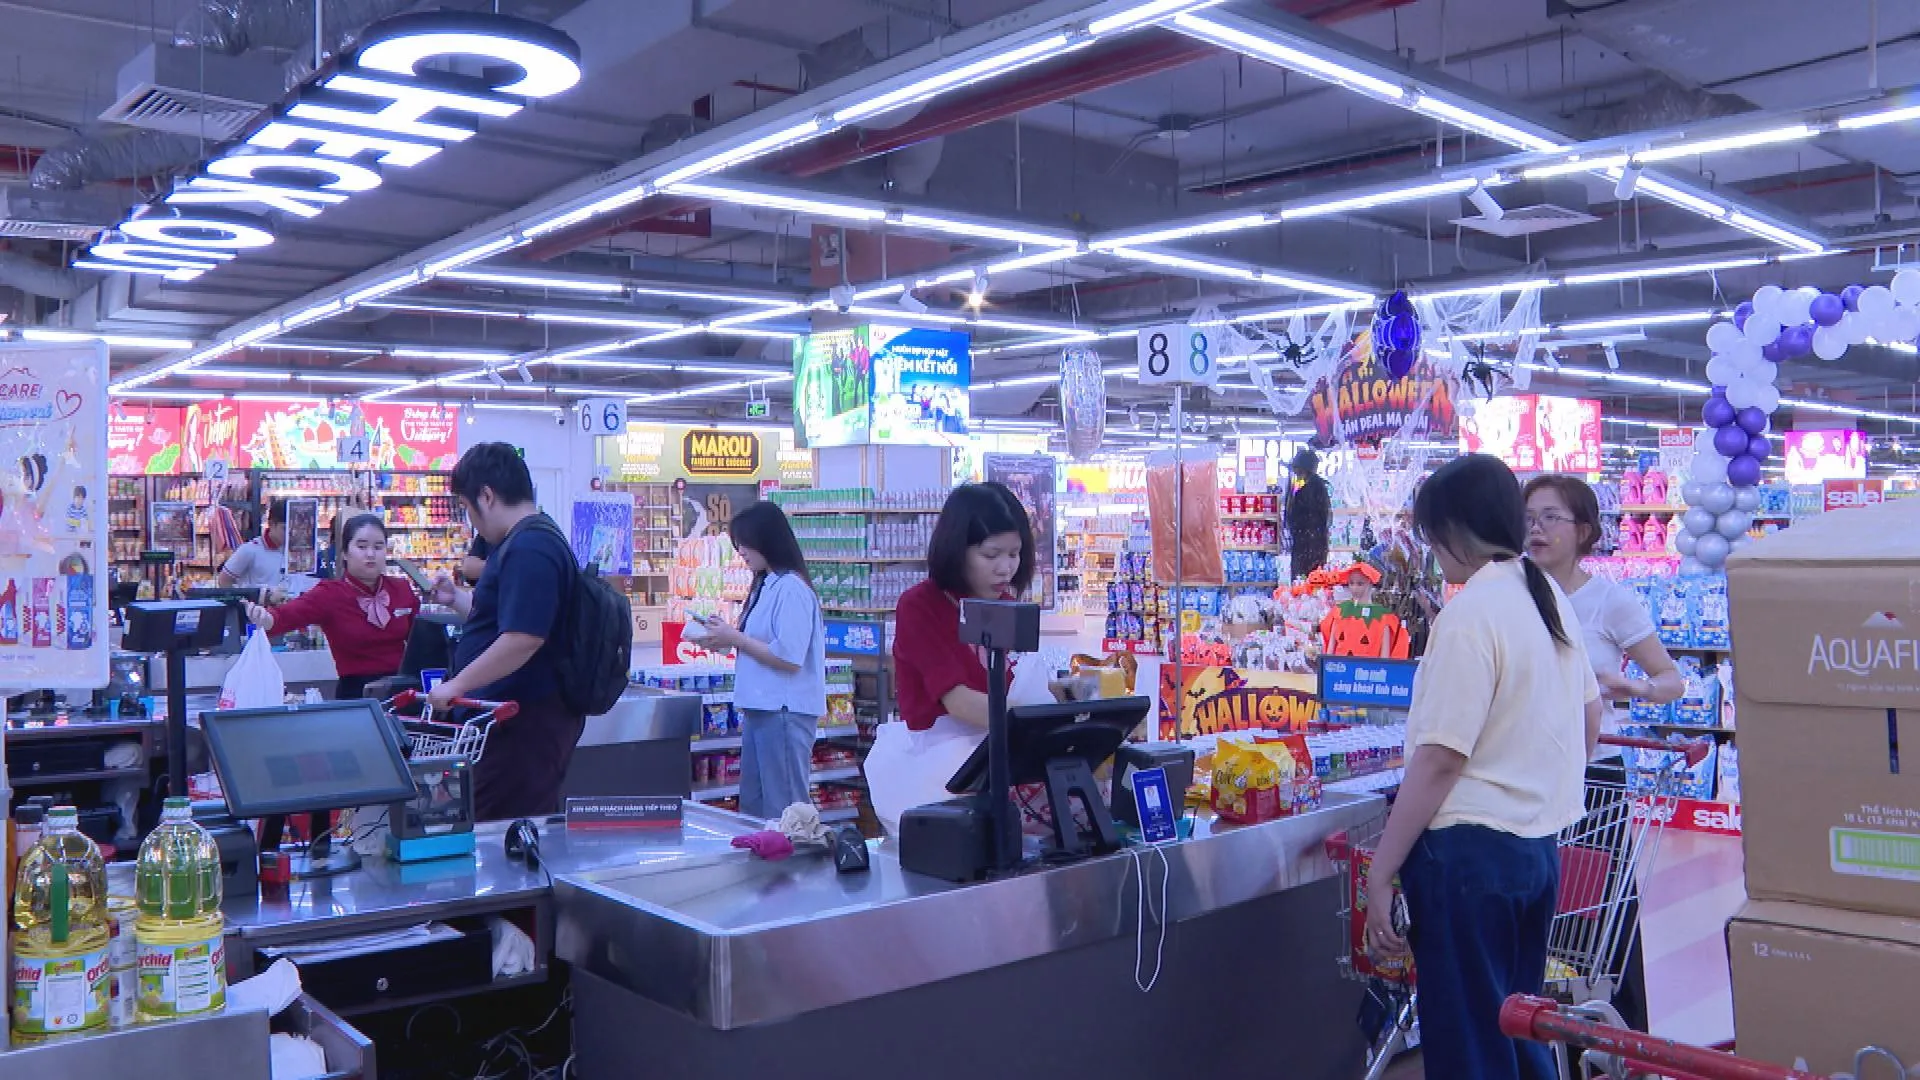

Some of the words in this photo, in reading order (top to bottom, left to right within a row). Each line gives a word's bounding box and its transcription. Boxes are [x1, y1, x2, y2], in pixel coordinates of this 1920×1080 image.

[1148, 333, 1170, 376] 8
[1189, 332, 1209, 376] 8
[580, 403, 592, 432] 6
[603, 403, 621, 432] 6
[691, 434, 752, 456] MAROU
[1662, 429, 1692, 445] sale
[350, 439, 363, 460] 4
[212, 462, 224, 479] 2
[1827, 483, 1881, 505] sale
[1751, 940, 1769, 957] 12
